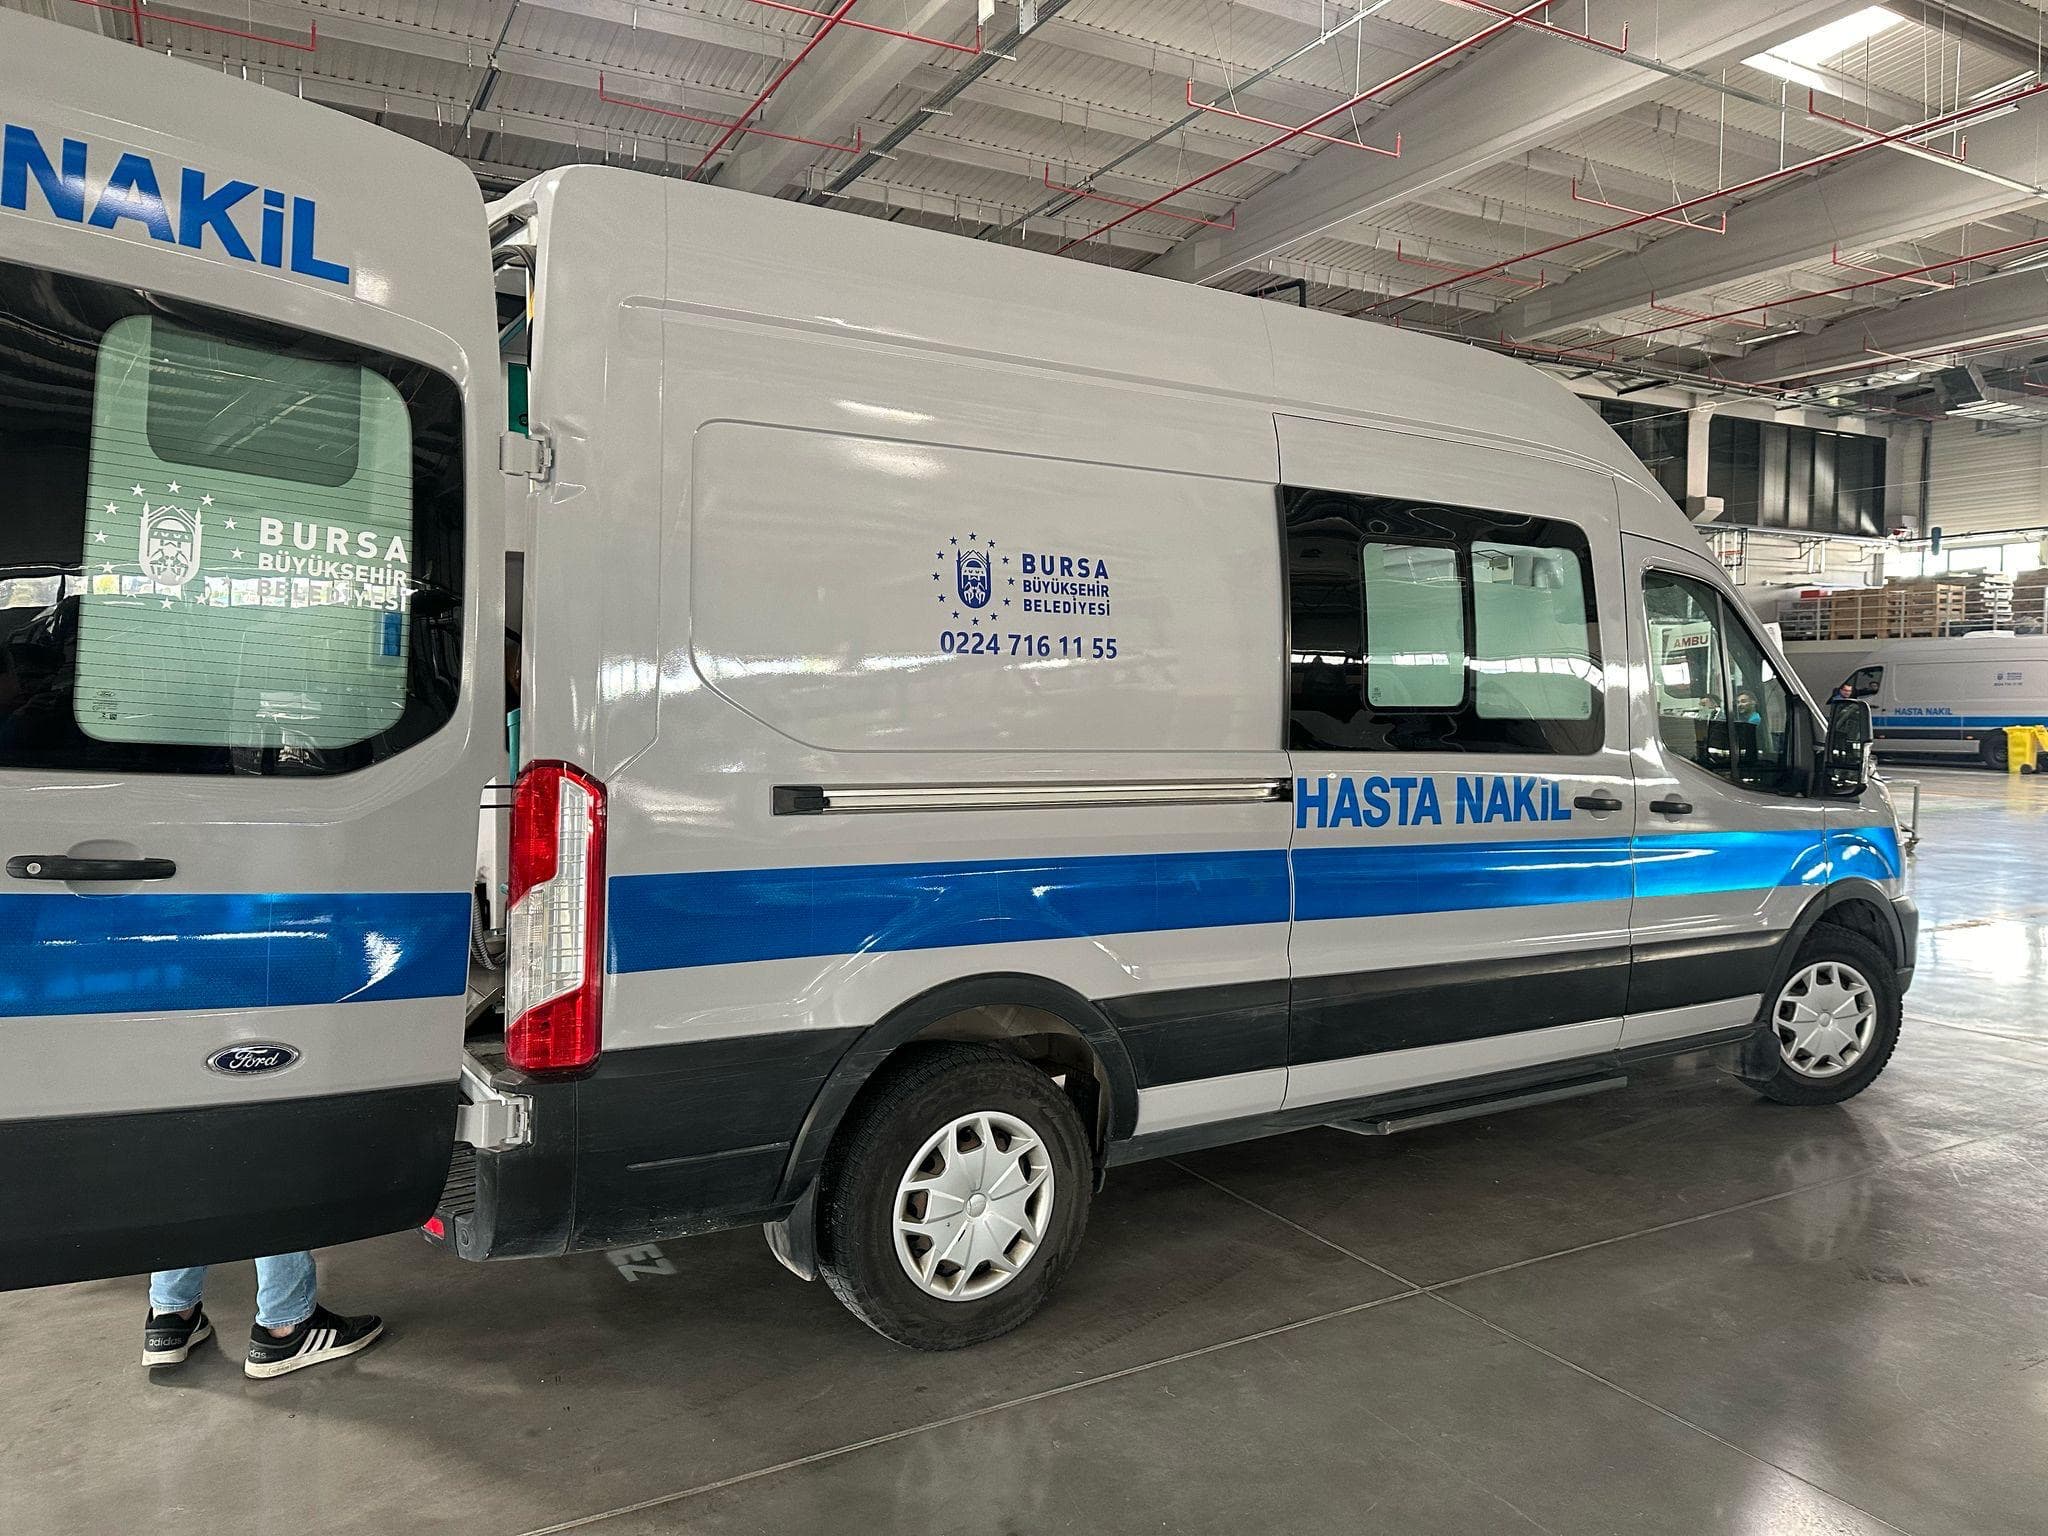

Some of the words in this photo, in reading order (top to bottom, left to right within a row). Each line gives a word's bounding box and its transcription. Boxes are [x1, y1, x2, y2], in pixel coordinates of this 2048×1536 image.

[259, 516, 408, 564] BURSA
[1022, 553, 1109, 579] BURSA
[1023, 597, 1110, 616] BELEDİYESİ
[940, 630, 1000, 655] 0224
[1008, 634, 1050, 657] 716
[1059, 636, 1082, 658] 11
[1092, 637, 1118, 660] 55
[1673, 634, 1709, 648] AMBU
[1895, 707, 1923, 716] HASTA
[1296, 776, 1441, 829] HASTA
[229, 1048, 280, 1069] Ford
[148, 1336, 183, 1348] adidas
[249, 1349, 267, 1359] das
